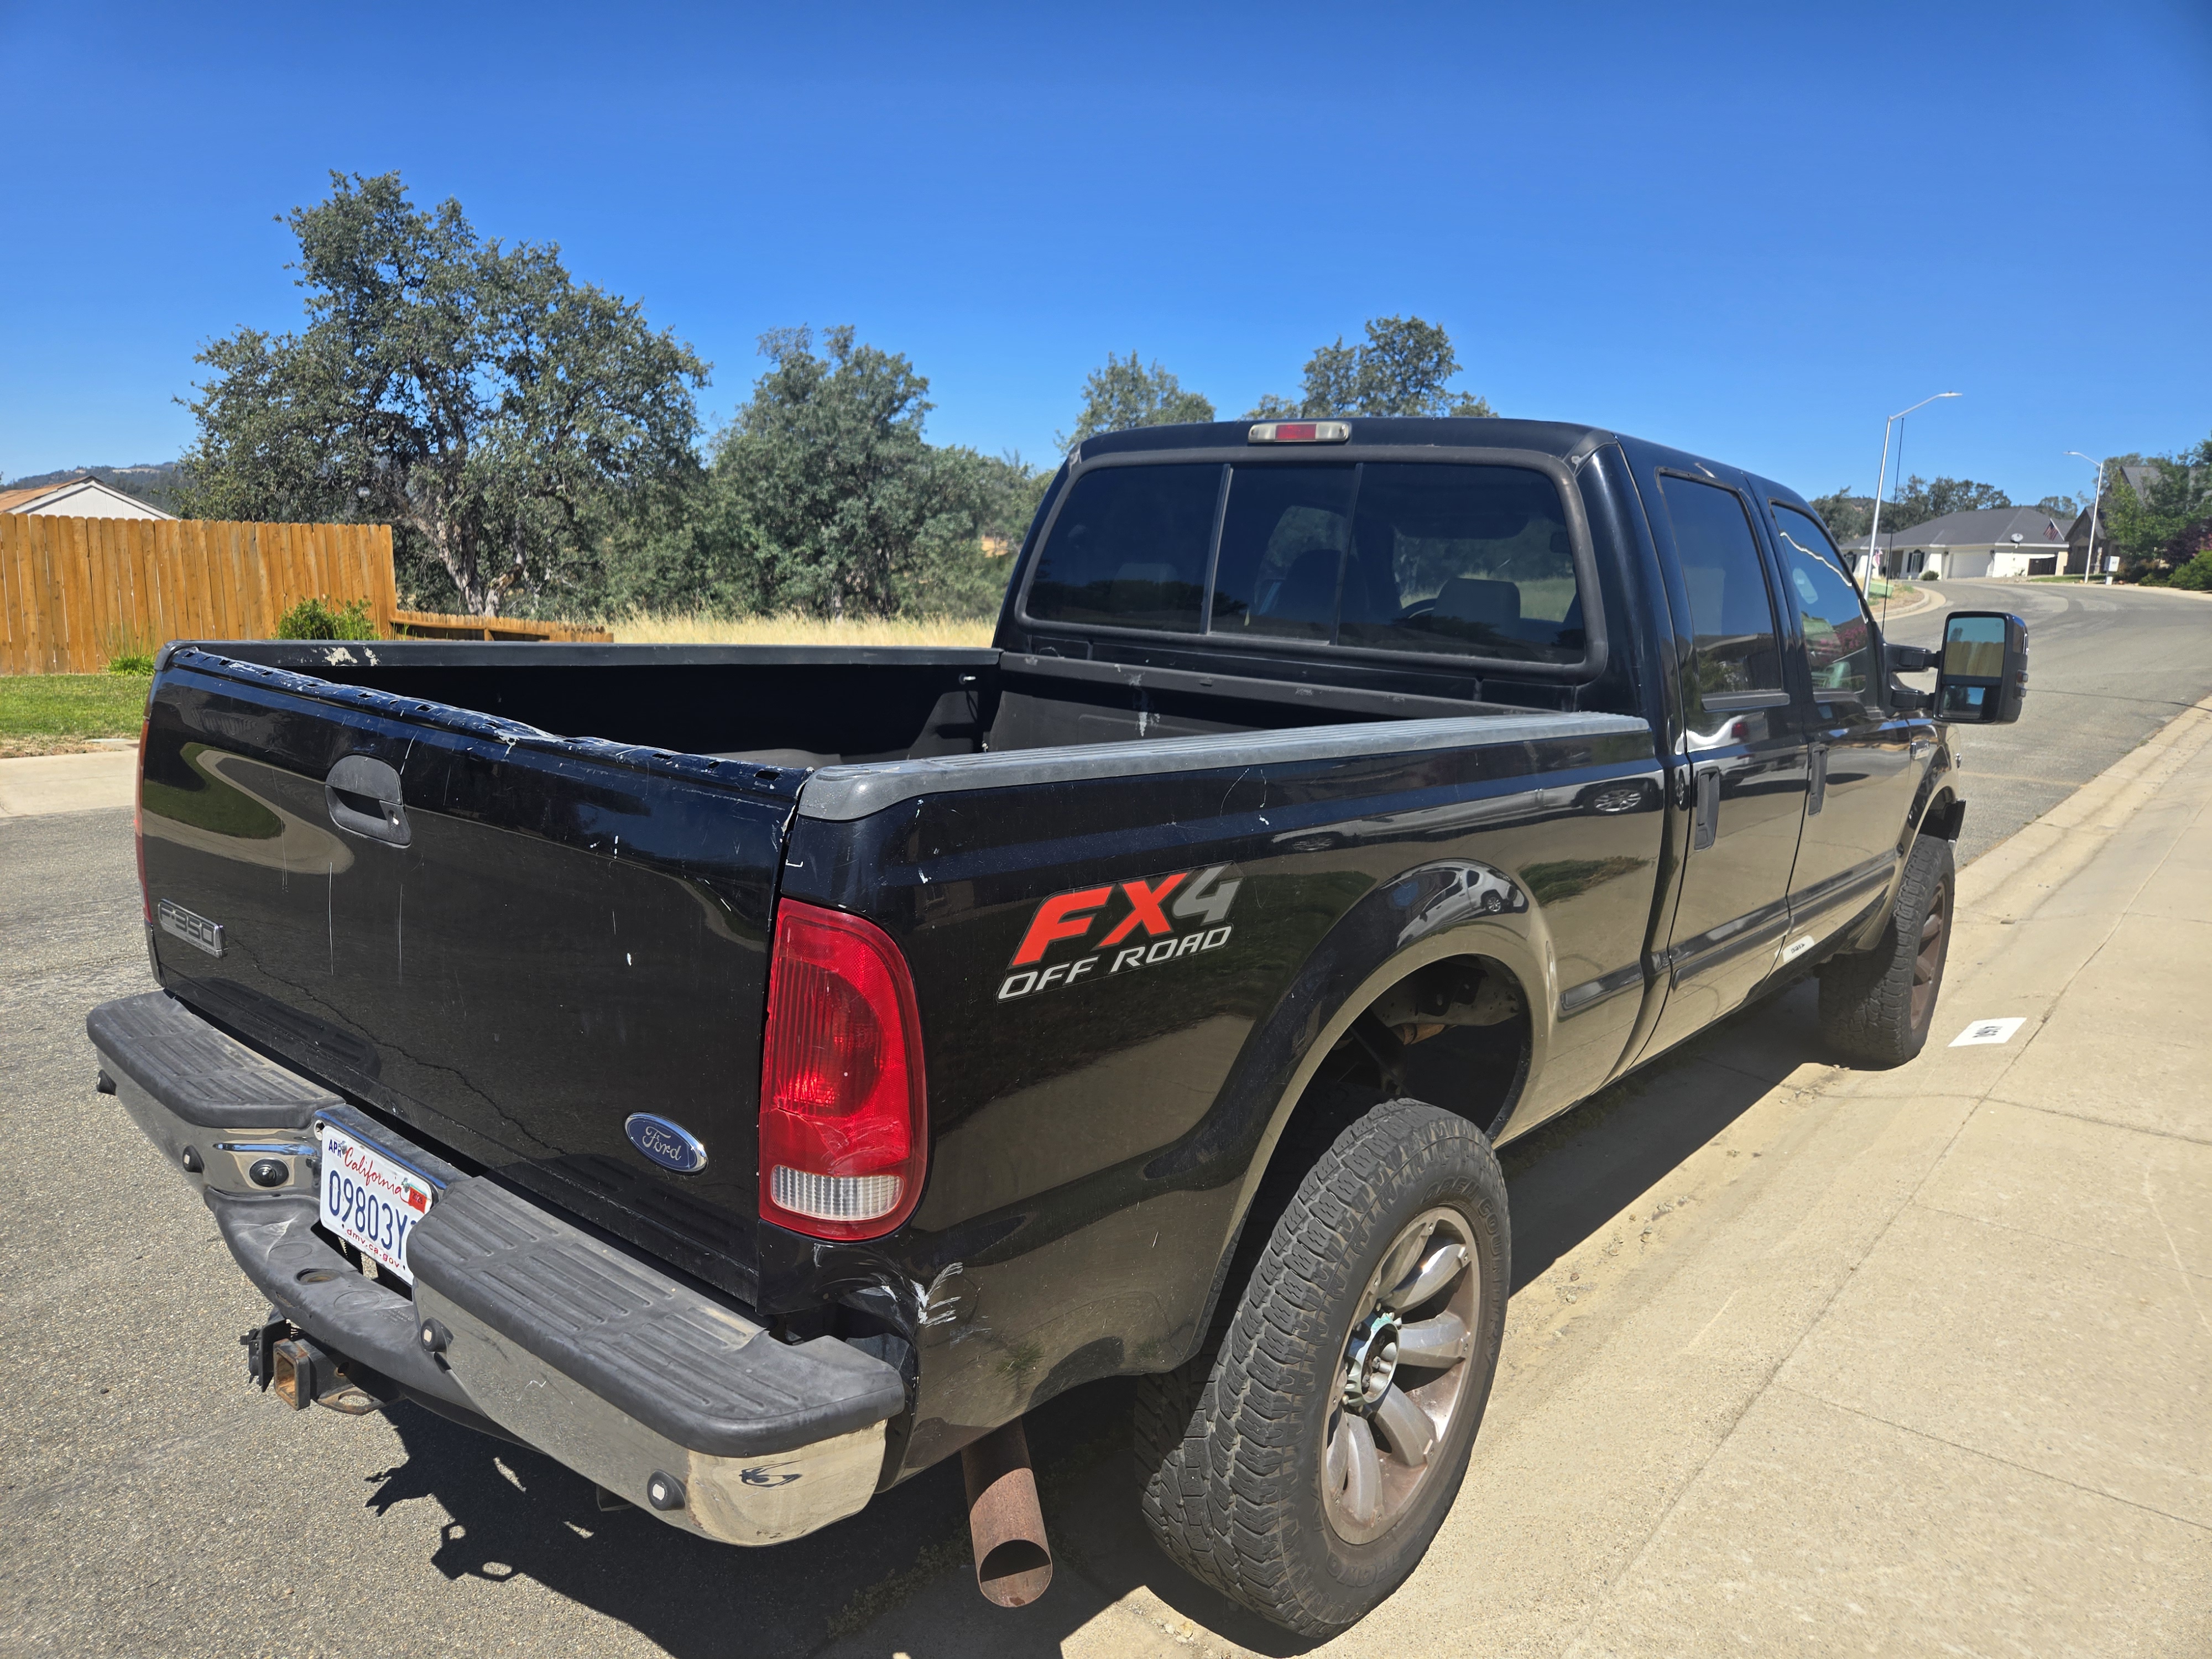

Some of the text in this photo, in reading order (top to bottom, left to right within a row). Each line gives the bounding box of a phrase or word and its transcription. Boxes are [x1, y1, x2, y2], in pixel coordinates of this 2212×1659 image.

[1012, 864, 1243, 966] FX4
[998, 925, 1232, 1000] OFF ROAD
[642, 1126, 682, 1161] Ford
[345, 1147, 409, 1203] California
[1420, 1175, 1481, 1206] OPEN
[329, 1170, 417, 1260] 09803Y
[347, 1229, 400, 1268] dmv.ca.gov
